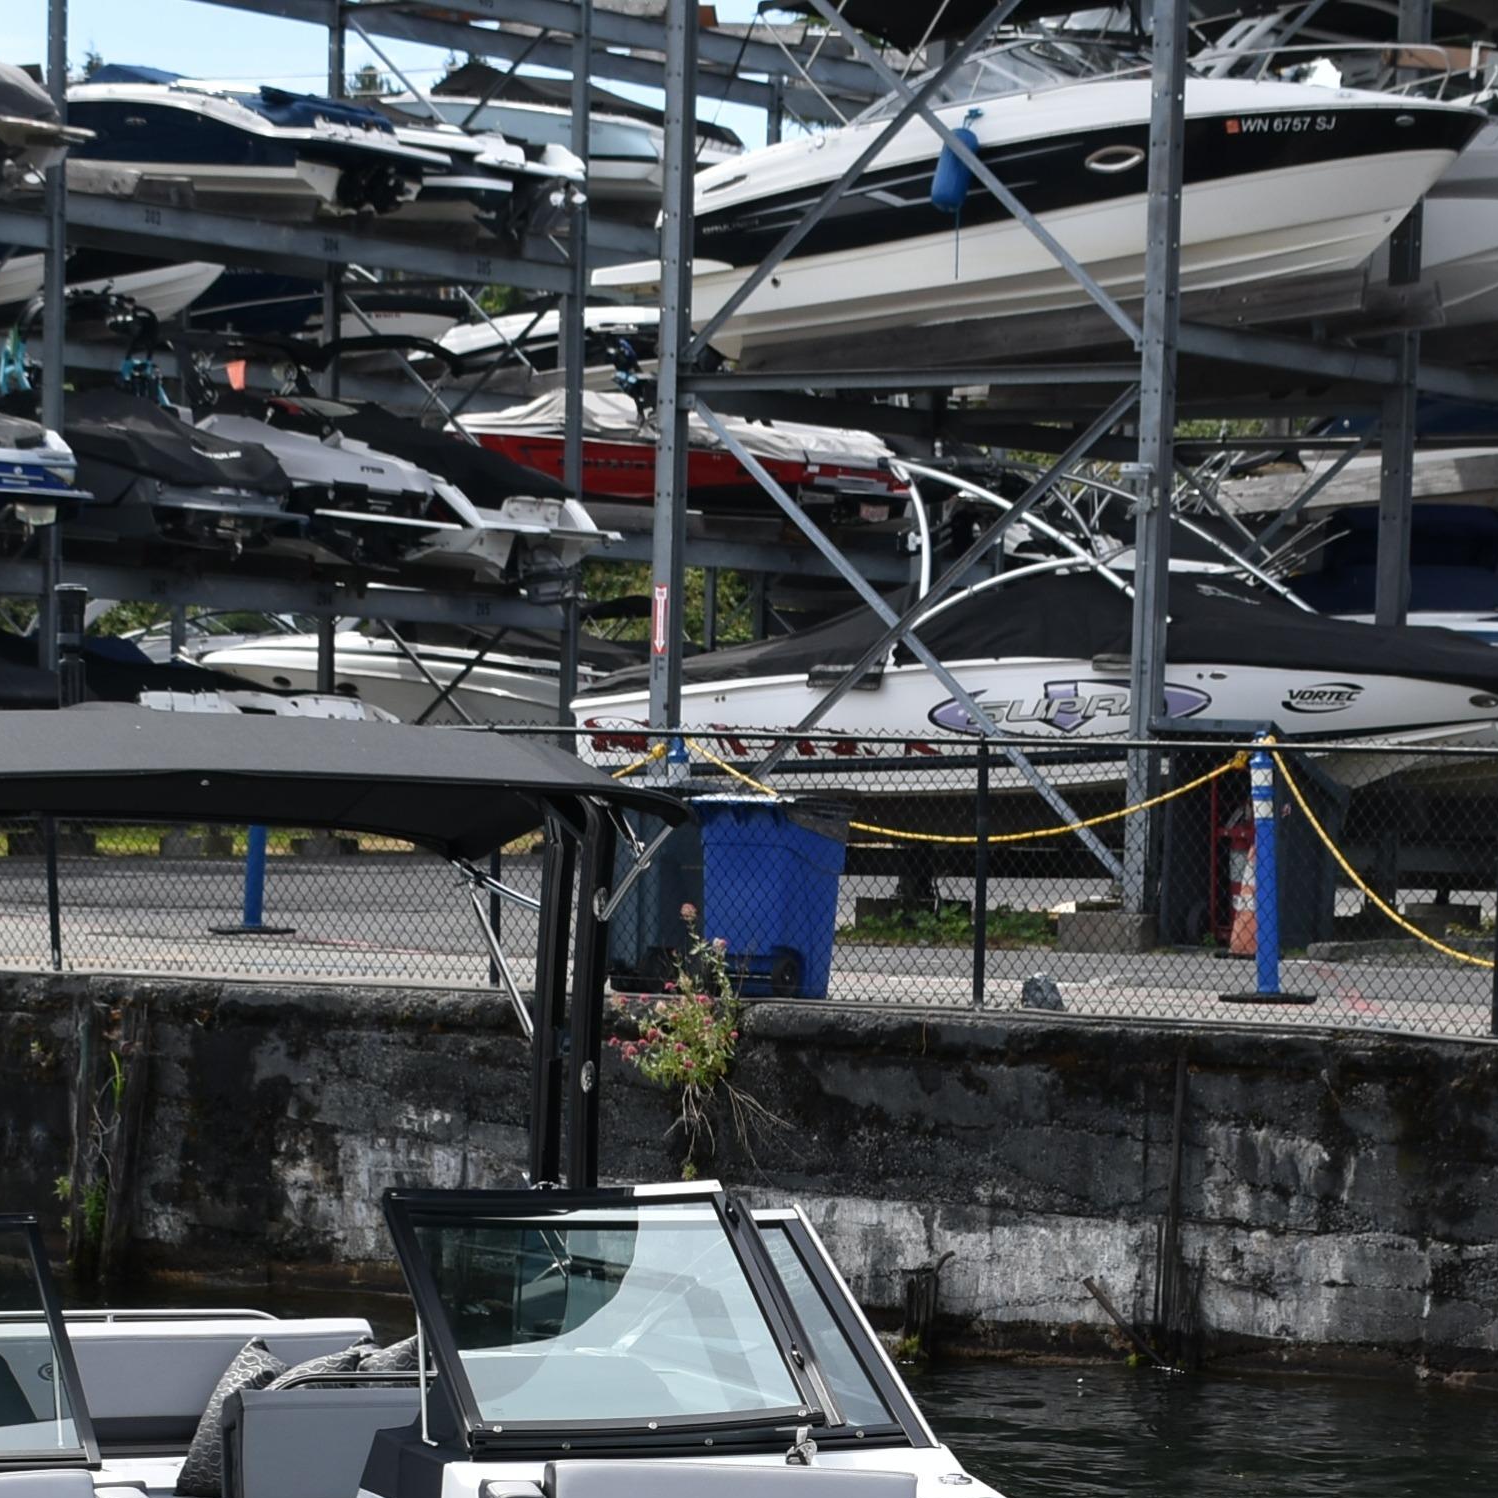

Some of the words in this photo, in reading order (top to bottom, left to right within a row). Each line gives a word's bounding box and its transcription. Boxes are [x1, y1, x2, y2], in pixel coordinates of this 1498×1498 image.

[1241, 118, 1269, 132] WN
[1273, 117, 1311, 132] 6757
[1315, 115, 1336, 131] SJ
[1288, 689, 1362, 702] VORTEC
[966, 691, 1167, 726] SUPR
